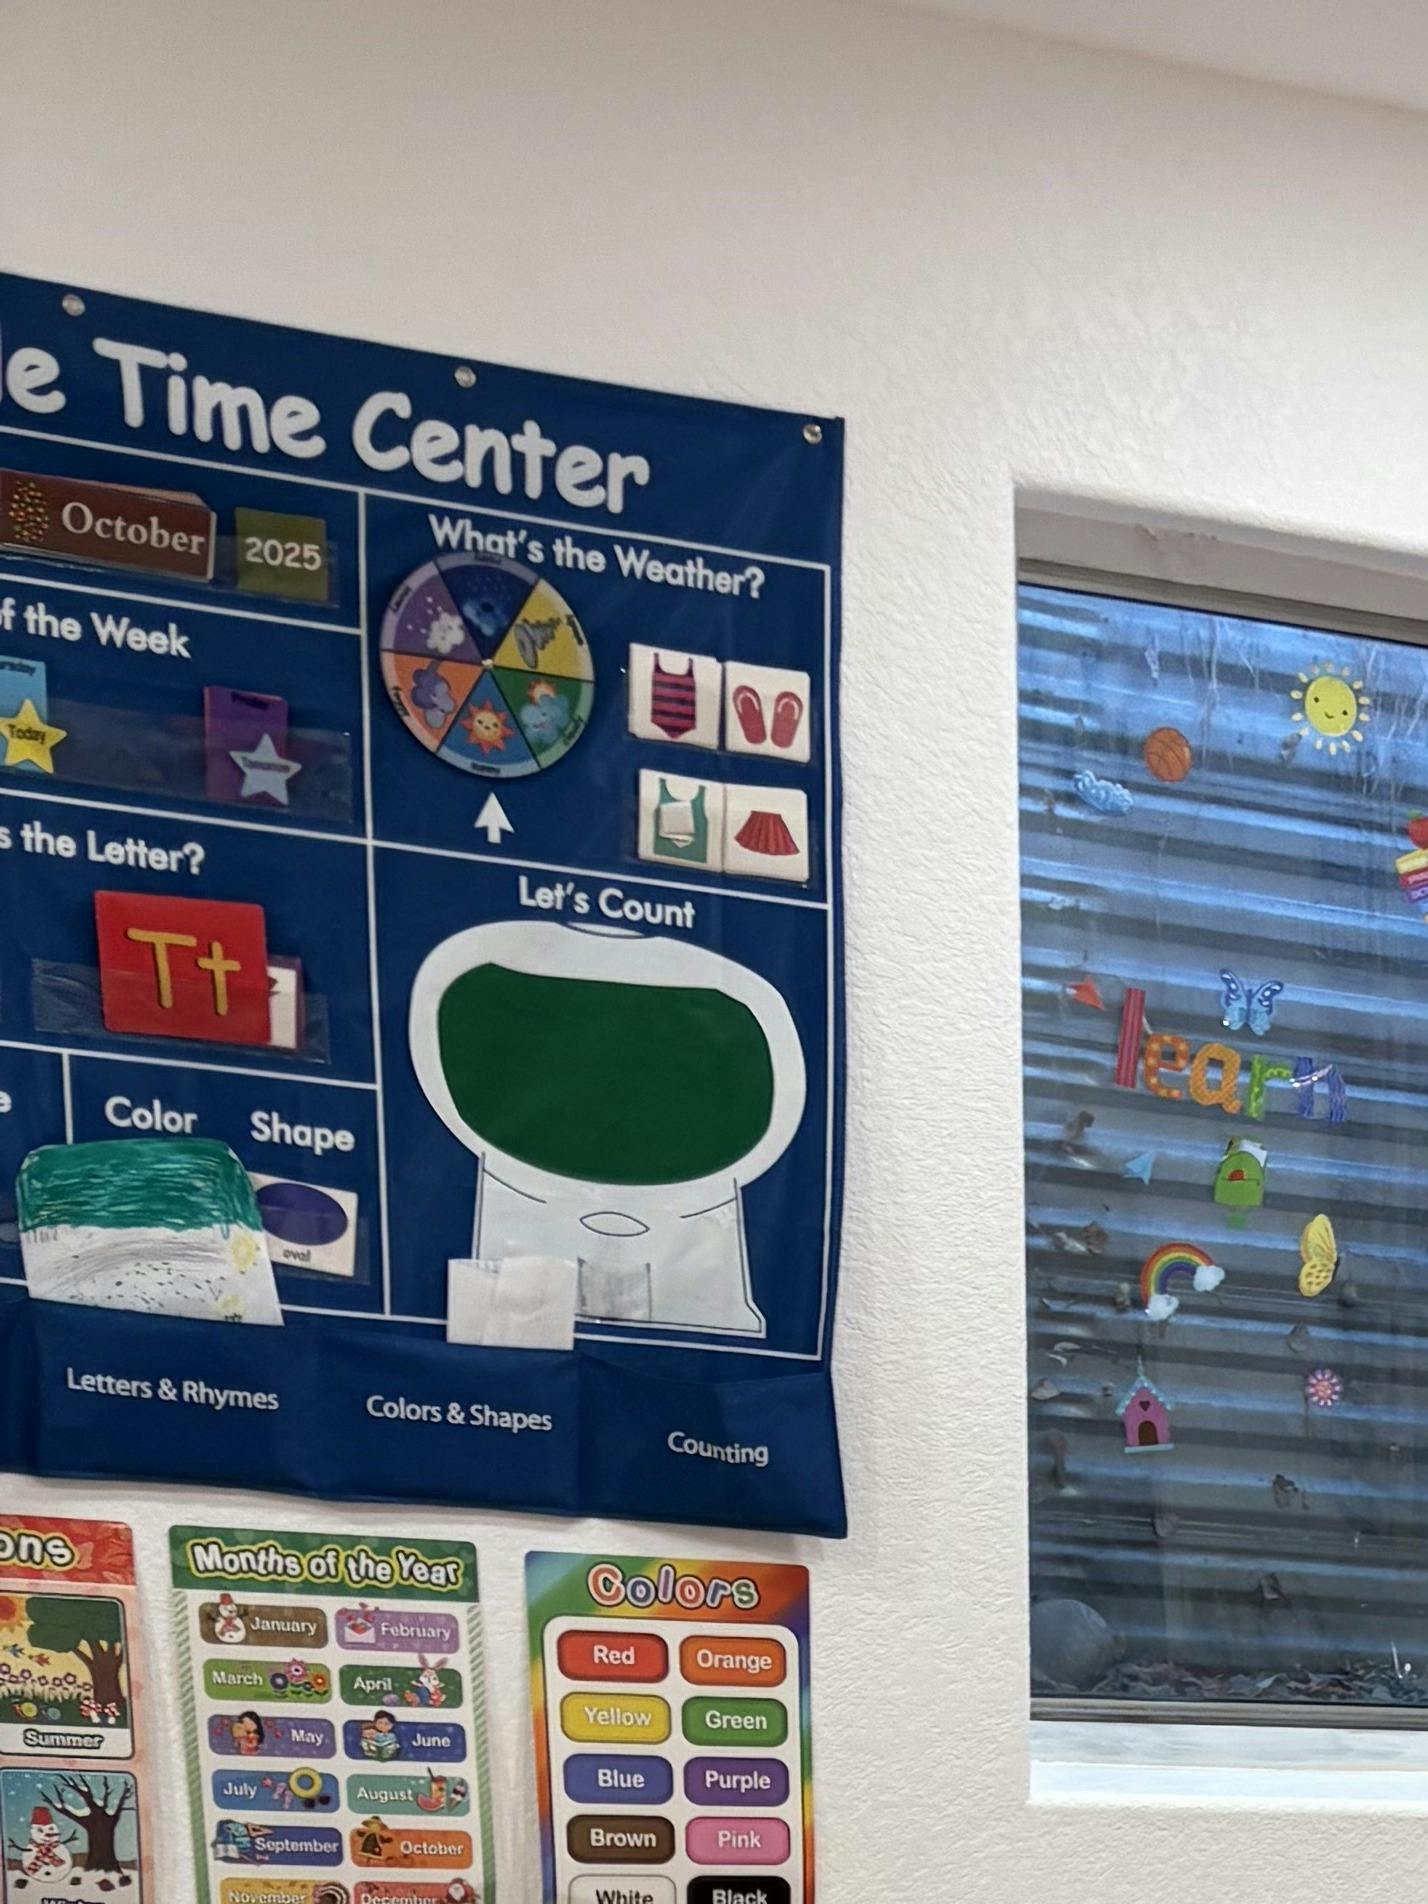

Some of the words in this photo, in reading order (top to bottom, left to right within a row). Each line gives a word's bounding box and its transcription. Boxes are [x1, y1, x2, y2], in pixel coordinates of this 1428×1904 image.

[93, 337, 326, 458] Time
[352, 391, 650, 514] Center
[62, 502, 205, 556] October
[245, 537, 321, 570] 2025
[429, 514, 545, 563] What's
[553, 537, 606, 573] the
[613, 544, 765, 598] Weather?
[24, 602, 82, 641] the
[90, 612, 192, 659] Week
[8, 723, 47, 744] Today
[21, 821, 76, 857] the
[88, 830, 205, 875] Letter?
[519, 876, 589, 915] Let's
[599, 887, 695, 929] Count
[126, 928, 241, 1016] Tt
[1114, 987, 1347, 1123] learn
[105, 1096, 198, 1134] Color
[251, 1111, 354, 1155] Shape
[282, 1247, 311, 1262] oval
[67, 1368, 152, 1399] Letters
[157, 1378, 178, 1400] &
[183, 1380, 279, 1411] Rhymes
[367, 1395, 442, 1424] Colors
[447, 1403, 466, 1426] &
[469, 1405, 552, 1432] Shapes
[668, 1432, 769, 1468] Counting
[193, 1542, 301, 1577] Months
[311, 1552, 338, 1578] of
[348, 1553, 391, 1583] the
[398, 1555, 459, 1586] Year
[587, 1563, 759, 1609] Colors
[250, 1617, 317, 1637] January
[381, 1623, 451, 1641] February
[593, 1645, 635, 1665] Red
[697, 1649, 772, 1673] Orange
[212, 1671, 263, 1686] March
[354, 1677, 392, 1693] April
[584, 1706, 652, 1727] Yellow
[705, 1711, 767, 1730] Green
[24, 1730, 104, 1750] Summer
[291, 1730, 324, 1746] May
[412, 1733, 450, 1749] June
[598, 1770, 644, 1789] Blue
[705, 1771, 771, 1792] Purple
[223, 1782, 257, 1799] July
[357, 1787, 414, 1804] August
[255, 1837, 339, 1856] September
[590, 1828, 656, 1847] Brown
[718, 1830, 761, 1848] Pink
[401, 1841, 465, 1856] October
[229, 1891, 306, 1904] November
